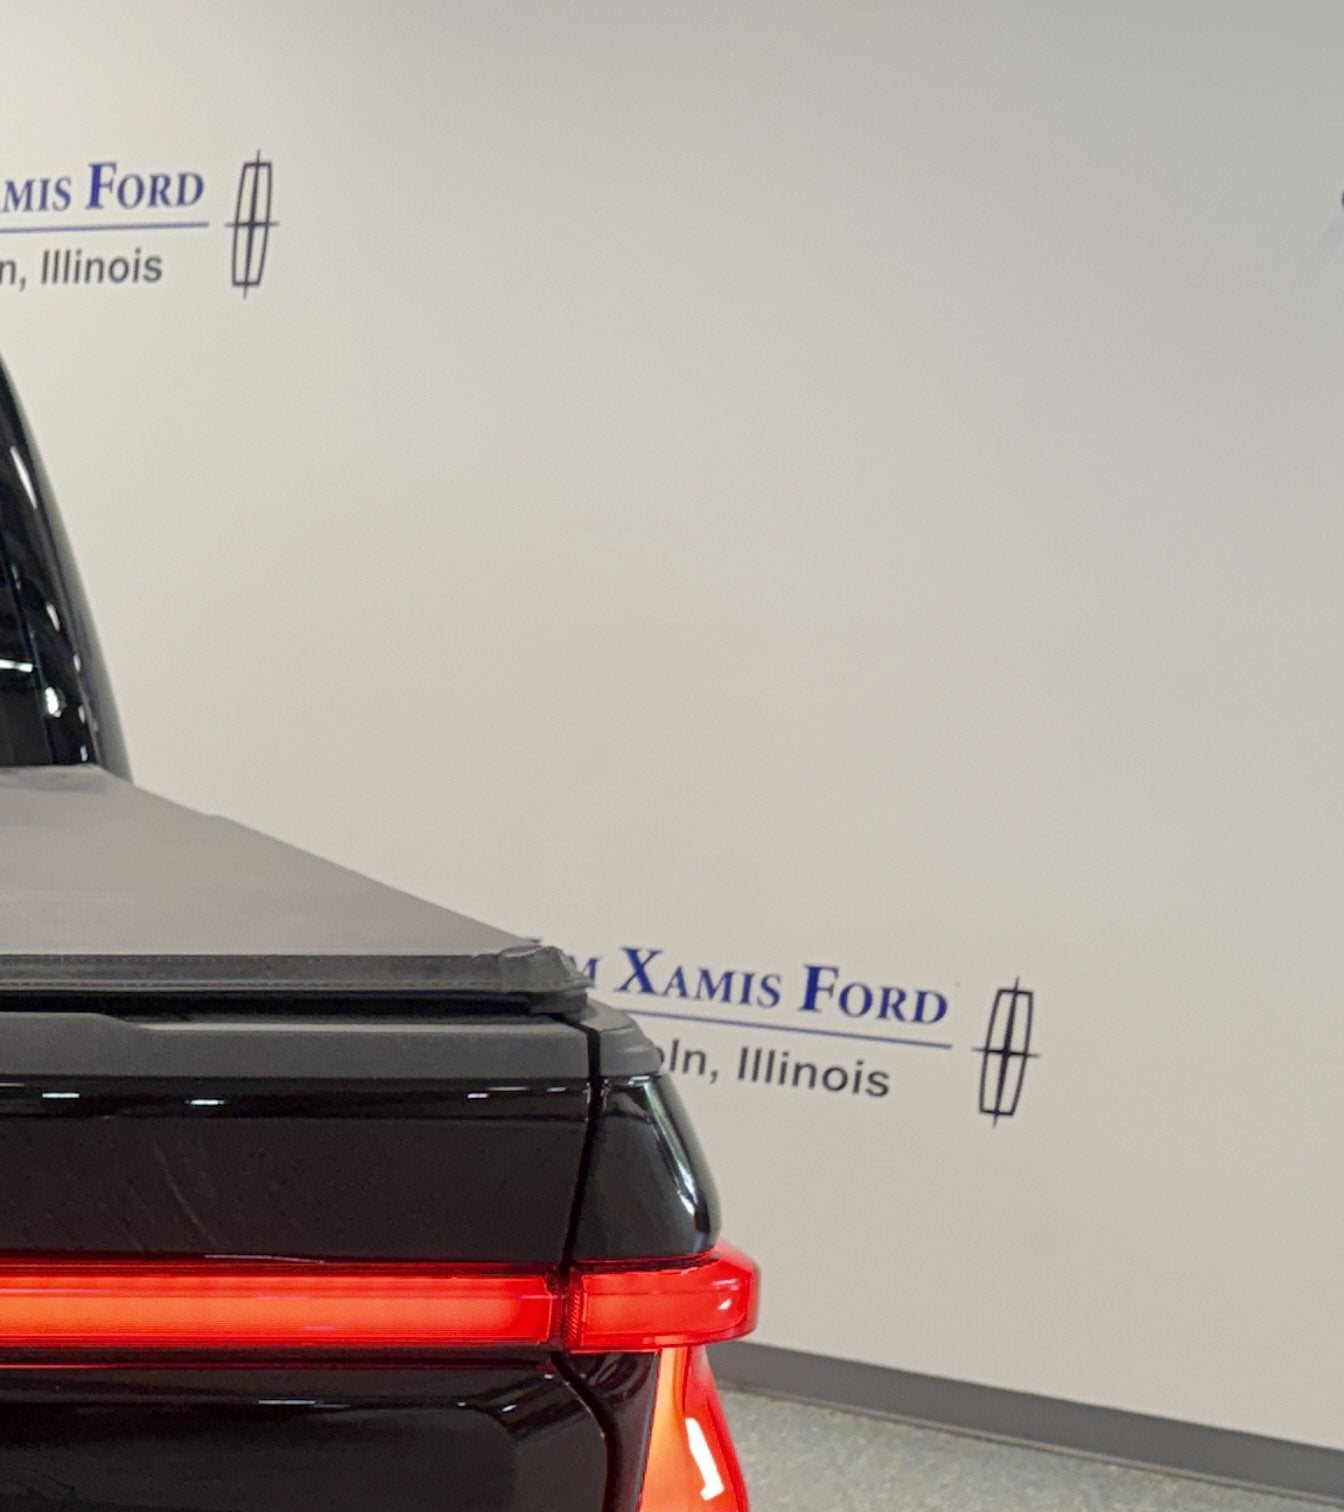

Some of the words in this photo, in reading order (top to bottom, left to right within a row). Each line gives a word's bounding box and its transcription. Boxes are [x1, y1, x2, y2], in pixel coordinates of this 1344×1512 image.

[85, 161, 205, 210] FORD
[40, 248, 163, 285] Illinois
[614, 945, 783, 1009] XAMIS
[797, 964, 949, 1026] FORD
[737, 1045, 891, 1099] Illinois
